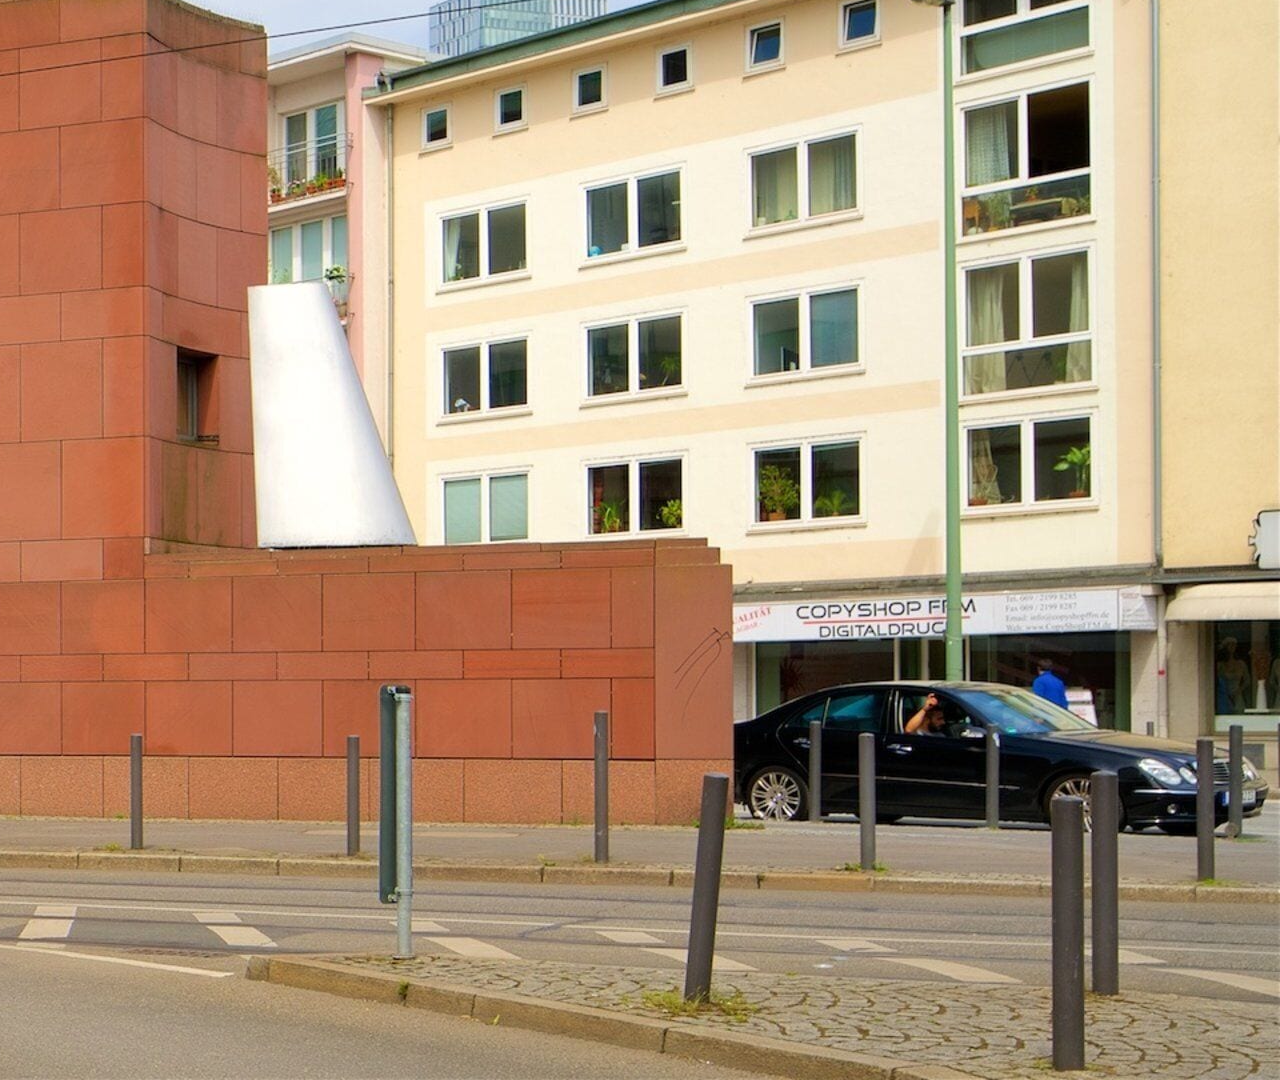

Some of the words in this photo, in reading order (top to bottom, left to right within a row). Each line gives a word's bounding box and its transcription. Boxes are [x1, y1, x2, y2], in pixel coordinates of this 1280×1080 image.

[1039, 593, 1058, 602] 2199
[796, 600, 922, 620] COPYSHOP
[1005, 603, 1019, 612] Fax
[1039, 602, 1058, 612] 2199
[820, 621, 948, 639] DIGITALDRUC
